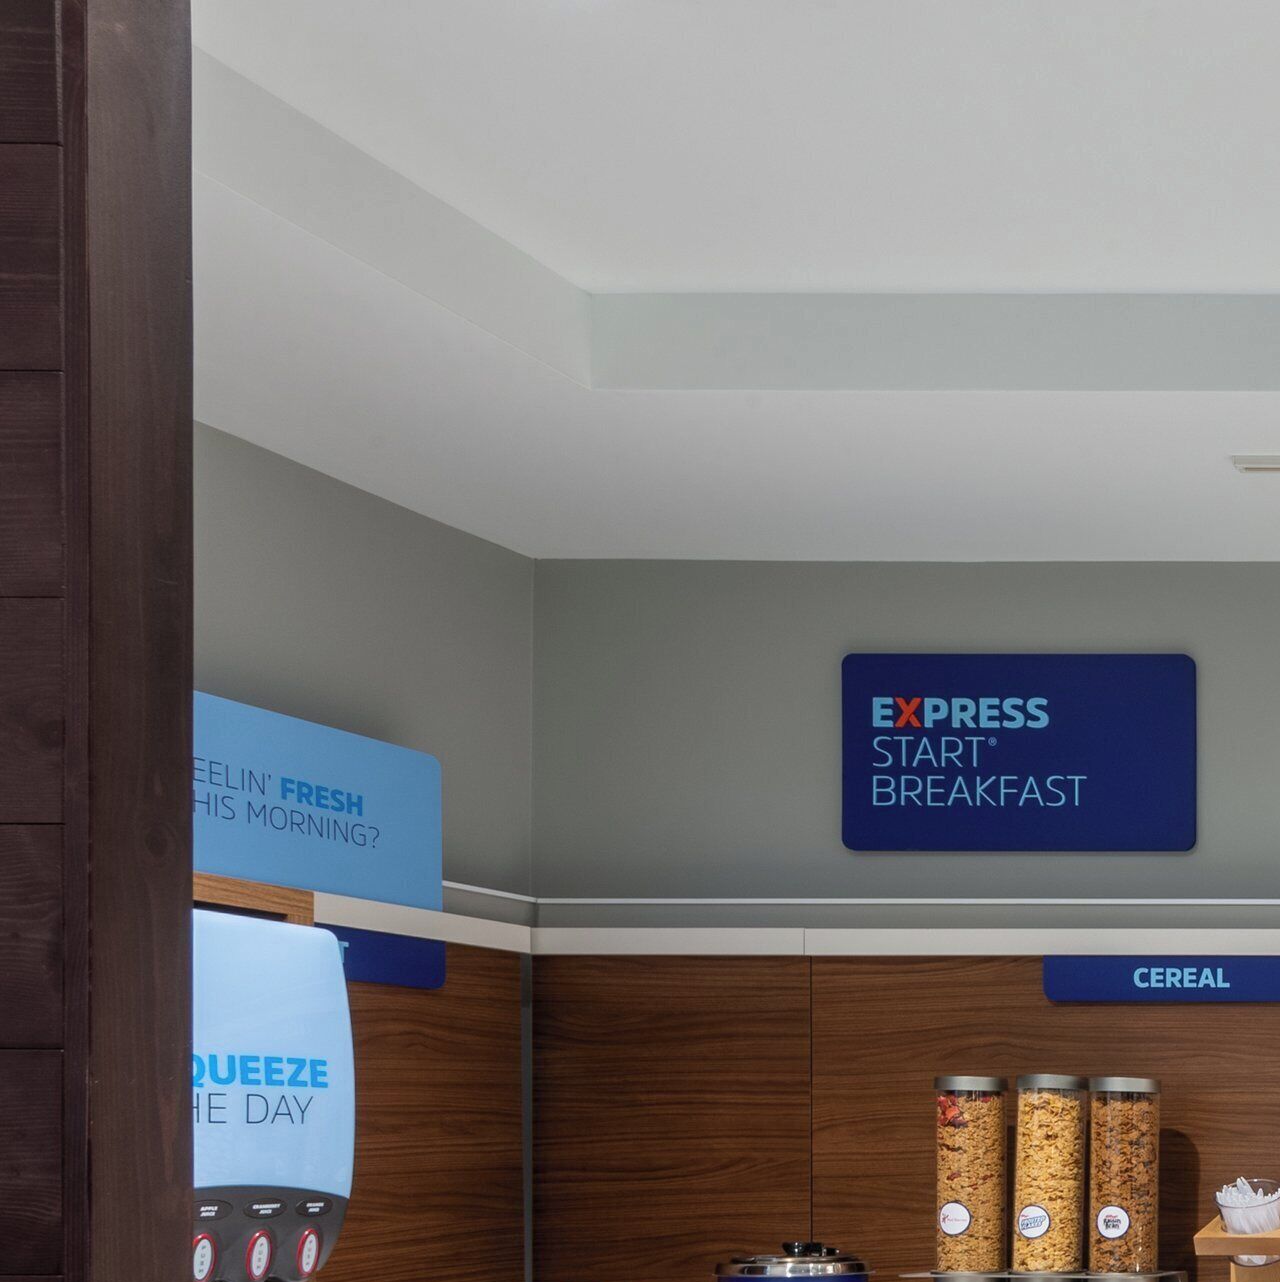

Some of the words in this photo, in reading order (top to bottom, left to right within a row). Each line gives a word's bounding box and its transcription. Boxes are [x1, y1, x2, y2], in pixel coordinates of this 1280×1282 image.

[872, 696, 1049, 729] EXPRESS
[192, 756, 272, 796] EELIN'
[280, 776, 364, 817] FRESH
[872, 775, 1088, 806] BREAKFAST
[192, 788, 236, 820] HIS
[247, 800, 381, 849] MORNING?
[1133, 967, 1231, 988] CEREAL
[246, 1093, 314, 1125] DAY
